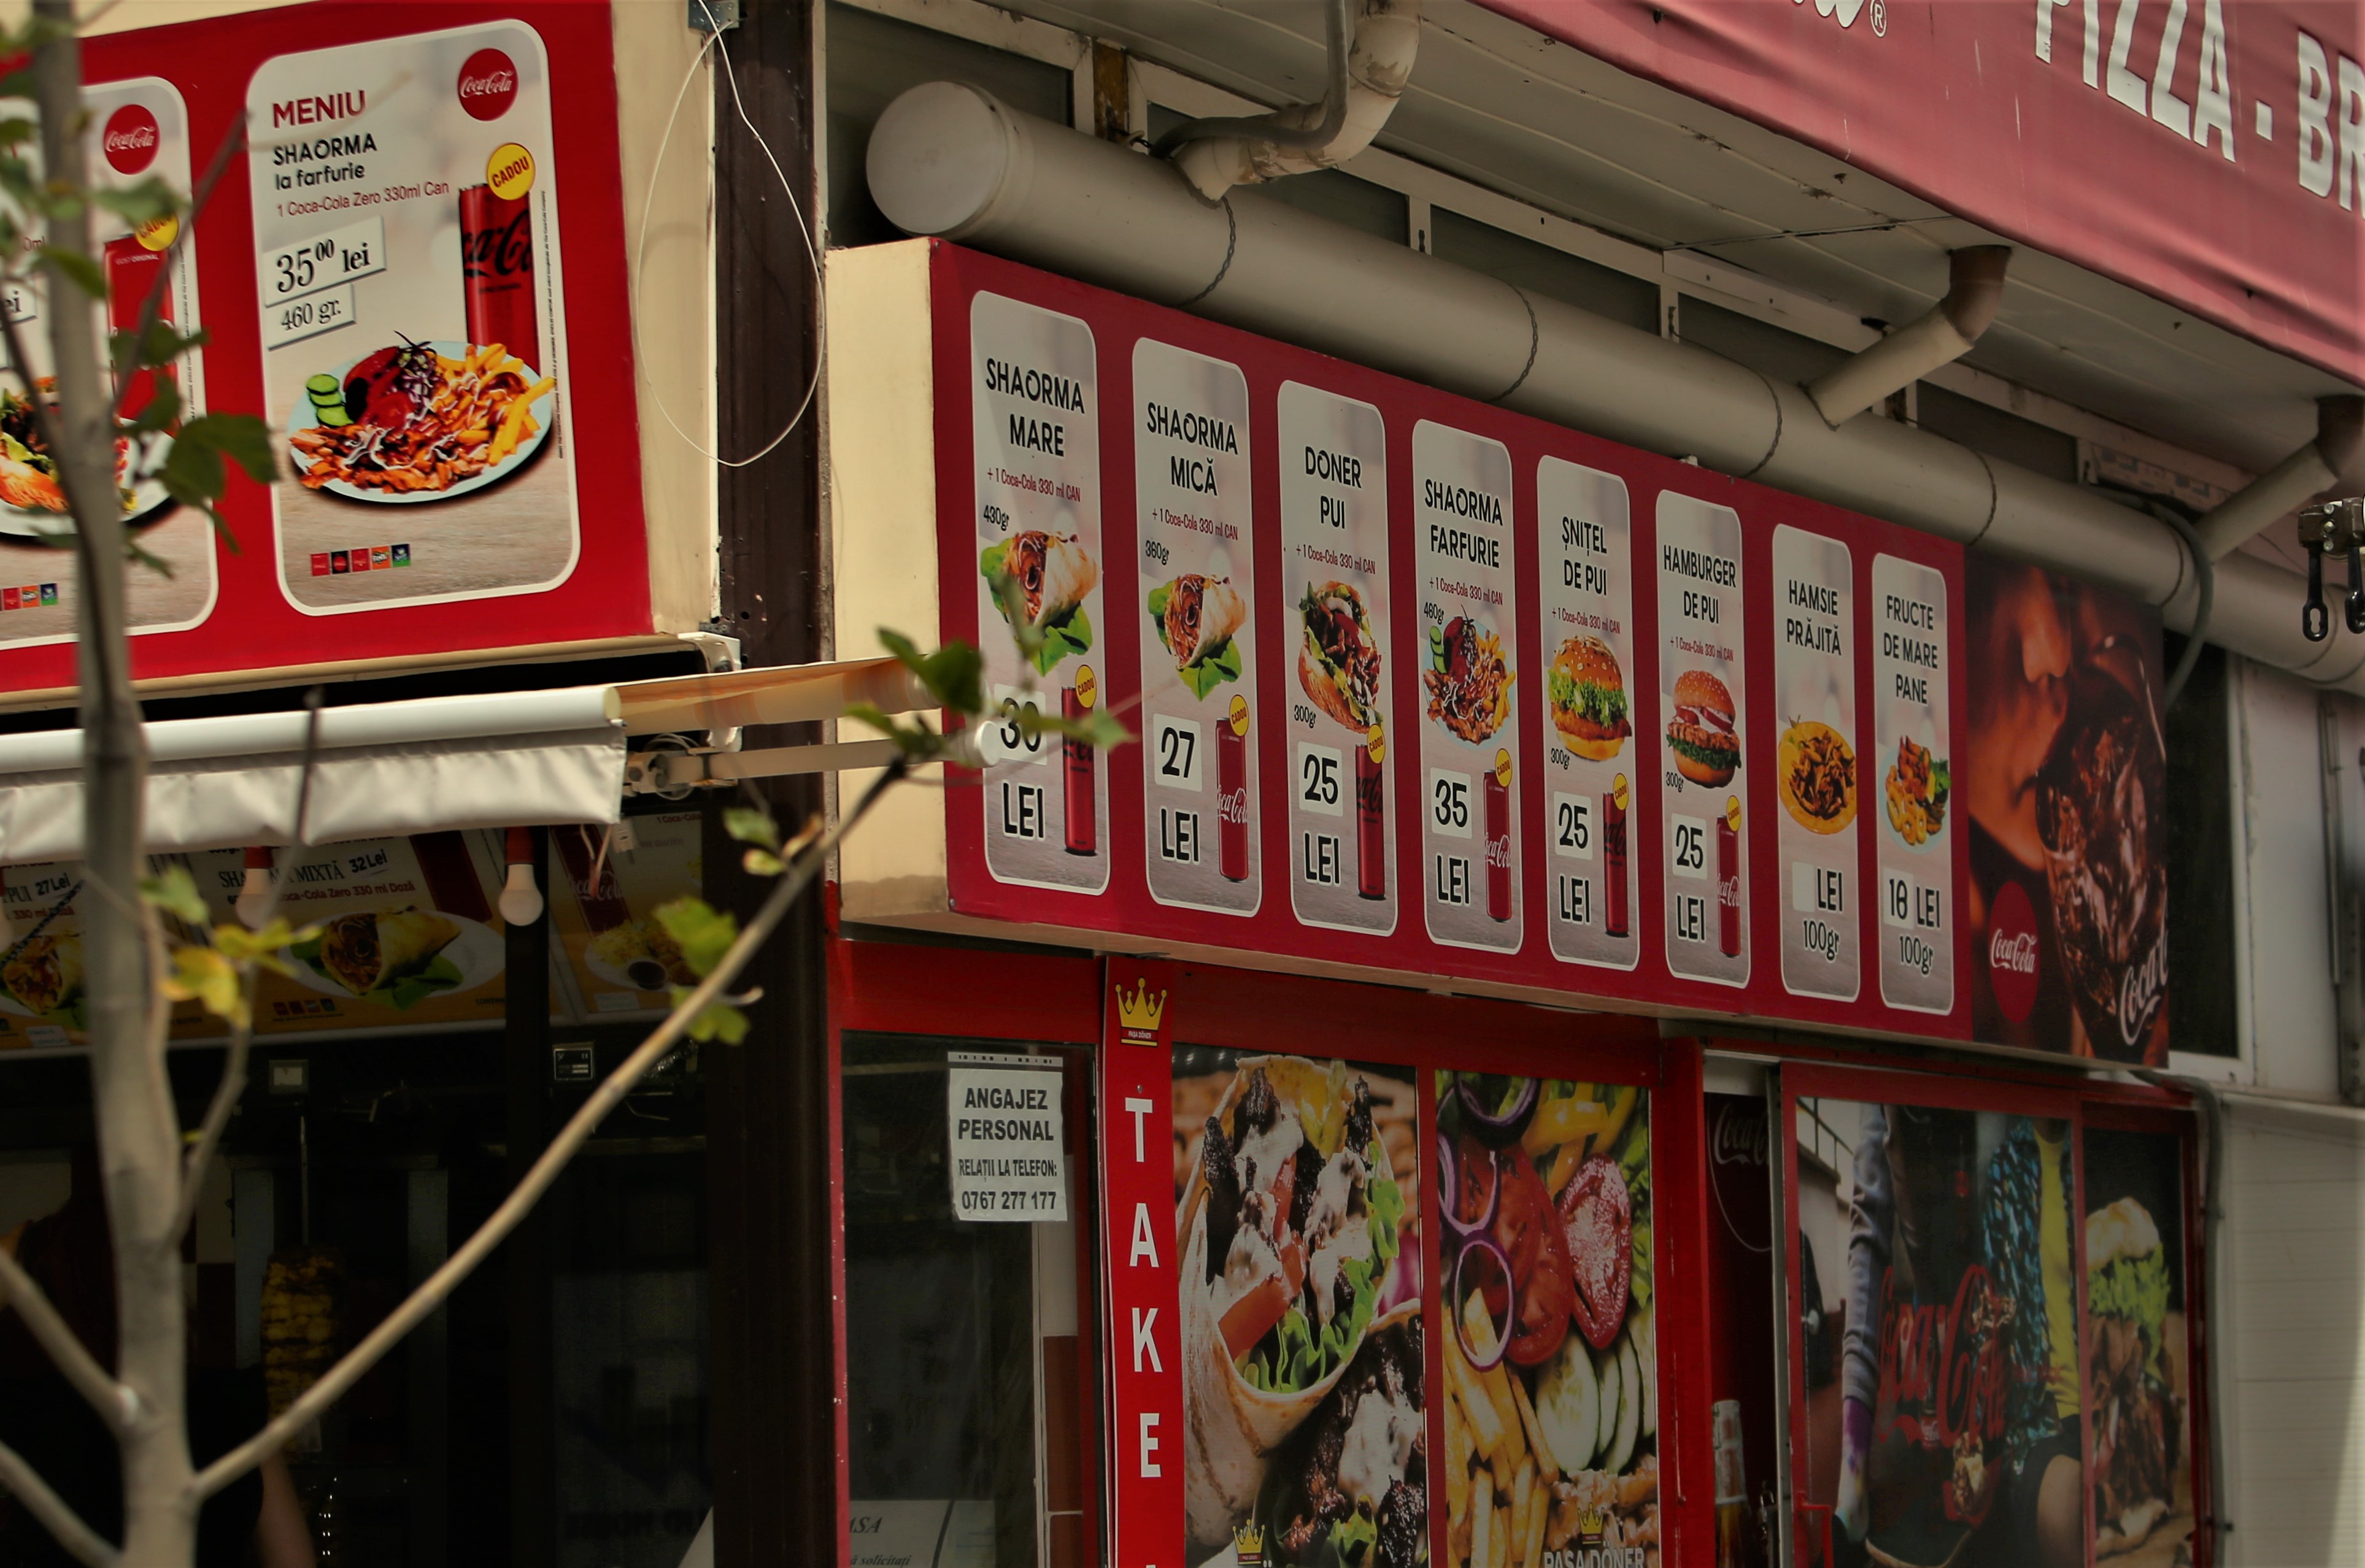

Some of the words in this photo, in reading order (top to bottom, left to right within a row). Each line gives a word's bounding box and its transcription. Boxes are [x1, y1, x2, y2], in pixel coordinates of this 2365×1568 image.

[460, 69, 514, 99] Coca-Cola
[272, 90, 366, 129] MENIU
[105, 126, 156, 152] Coca-Cola
[273, 133, 377, 166] SHAORMA
[276, 174, 291, 191] la
[297, 162, 365, 188] farfurie
[492, 156, 530, 188] CADOU
[277, 204, 284, 217] 1
[288, 193, 350, 217] Coca-Cola
[353, 188, 381, 206] Zero
[385, 183, 422, 203] 330ml
[425, 181, 449, 196] Can
[342, 243, 371, 273] lei
[282, 303, 314, 331] 460
[319, 299, 341, 324] gr.
[986, 358, 1085, 414] SHAORMA
[1009, 414, 1064, 457] MARE
[1147, 402, 1238, 455] SHAORMA
[1171, 456, 1217, 496] MICĂ
[1305, 446, 1362, 488] DONER
[1001, 469, 1036, 491] Coca-Cola
[1038, 478, 1054, 496] 330
[1056, 483, 1064, 498] ml
[1067, 485, 1081, 502] CAN
[1425, 478, 1503, 526] SHAORMA
[983, 504, 1009, 530] 430gr
[1165, 509, 1197, 531] Coca-Cola
[1199, 518, 1214, 534] 330
[1216, 522, 1223, 537] ml
[1225, 523, 1238, 540] CAN
[1321, 496, 1345, 529] PUI
[1145, 540, 1170, 566] 360gr
[1430, 525, 1500, 568] FARFURIE
[1562, 516, 1607, 556] ȘNIȚEL
[1308, 545, 1338, 566] Coca-Cola
[1340, 553, 1353, 569] 330
[1354, 557, 1362, 571] ml
[1363, 559, 1376, 574] CAN
[1564, 559, 1582, 590] DE
[1586, 565, 1607, 596] PUI
[1664, 544, 1736, 588] HAMBURGER
[1440, 578, 1468, 598] Coca-Cola
[1470, 585, 1482, 601] 330
[1483, 588, 1490, 603] ml
[1491, 590, 1503, 605] CAN
[1684, 591, 1699, 619] DE
[1702, 595, 1719, 624] PUI
[1789, 579, 1838, 616] HAMSIE
[1424, 601, 1444, 625] 460gr
[1562, 608, 1588, 627] Coca-Cola
[1589, 615, 1601, 629] 330
[1602, 618, 1608, 632] ml
[1609, 619, 1620, 634] CAN
[1886, 595, 1934, 631] FRUCTE
[1705, 644, 1716, 658] 330
[1716, 647, 1723, 659] ml
[1723, 648, 1734, 663] CAN
[1787, 616, 1842, 656] PRĂJITĂ
[1884, 632, 1900, 659] DE
[1903, 637, 1938, 669] MARE
[1078, 678, 1094, 696] CADOU
[1896, 674, 1927, 705] PANE
[1231, 707, 1247, 725] CADOU
[1294, 704, 1316, 728] 300gr
[1162, 727, 1195, 778] 27
[1369, 736, 1384, 753] CADOU
[1551, 747, 1570, 770] 300gr
[1304, 754, 1338, 805] 25
[1497, 760, 1510, 777] CADOU
[1666, 771, 1684, 793] 300gr
[1435, 779, 1467, 828] 35
[1614, 783, 1627, 800] CADOU
[1003, 783, 1043, 838] LEI
[1559, 802, 1588, 849] 25
[1161, 809, 1199, 862] LEI
[1676, 824, 1703, 869] 25
[1305, 833, 1340, 884] LEI
[284, 890, 327, 902] oca-Cola
[327, 888, 351, 898] Zero
[352, 885, 372, 896] 330
[375, 883, 388, 894] ml
[389, 880, 416, 892] Doză
[1437, 855, 1469, 904] LEI
[1818, 868, 1842, 912] LEI
[1560, 875, 1590, 923] LEI
[1916, 886, 1940, 928] LEI
[1676, 895, 1705, 940] LEI
[1804, 920, 1839, 961] 100gr
[1900, 936, 1934, 975] 100gr
[1990, 927, 2037, 974] Coca-Cola
[964, 1088, 1048, 1110] ANGAJEZ
[958, 1119, 1054, 1141] PERSONAL
[998, 1159, 1011, 1177] LA
[1013, 1159, 1057, 1177] TELEFON:
[962, 1191, 997, 1210] 0767
[1001, 1191, 1027, 1210] 277
[1032, 1191, 1057, 1210] 177
[1125, 1097, 1162, 1478] TAKE
